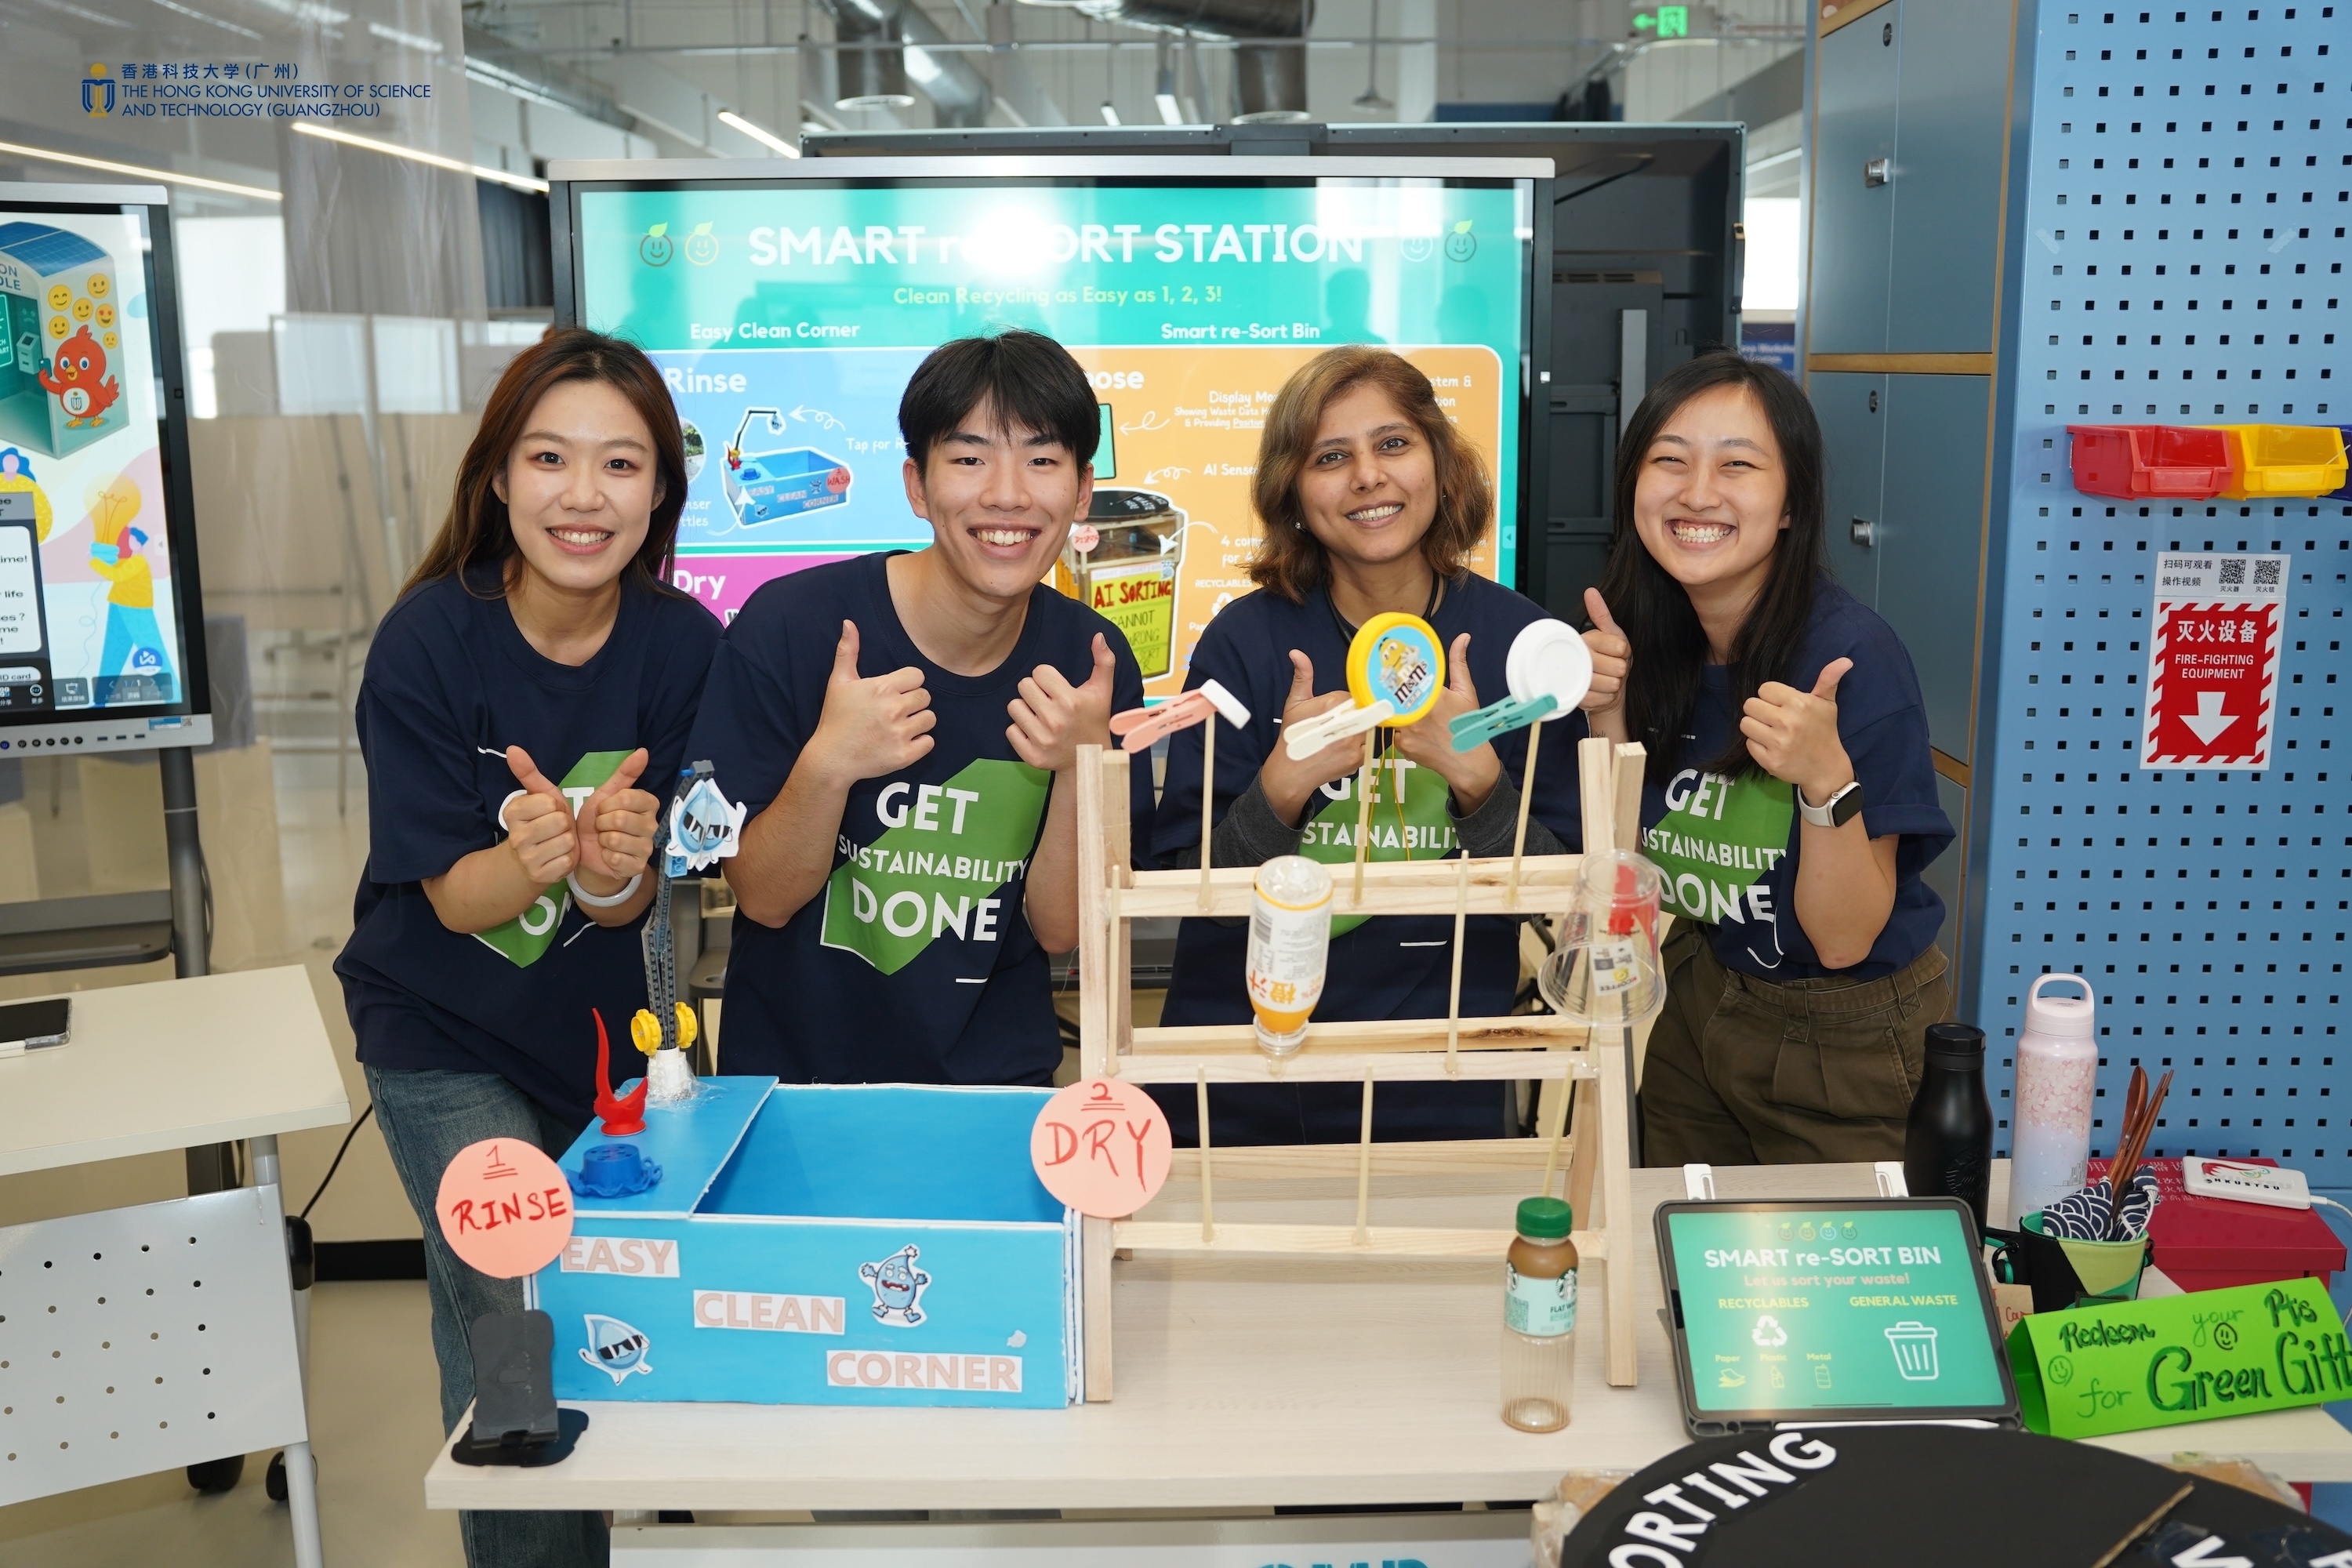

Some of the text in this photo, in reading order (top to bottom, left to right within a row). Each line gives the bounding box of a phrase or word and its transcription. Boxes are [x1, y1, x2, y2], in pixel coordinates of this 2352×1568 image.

[749, 225, 926, 266] SMART
[1154, 223, 1363, 263] STATION
[894, 285, 1222, 307] Clean Recycling as Easy as 1, 2, 3!
[691, 322, 860, 342] Easy Clean Corner
[1161, 323, 1320, 339] Smart re-Sort Bin
[665, 368, 747, 393] Rinse
[1209, 391, 1252, 407] Display
[1174, 407, 1207, 418] Showing
[1210, 407, 1236, 416] Waste
[1239, 407, 1259, 416] Data
[1193, 418, 1231, 430] Providing
[846, 437, 869, 455] Tap
[872, 440, 891, 454] for
[1203, 463, 1218, 476] AI
[827, 476, 851, 487] WASH
[804, 496, 838, 508] CORNER
[1221, 535, 1231, 547] 4
[1222, 554, 1240, 568] for
[2163, 559, 2213, 570] 扫码可观看
[673, 569, 727, 600] Dry
[1194, 579, 1253, 588] RECYCLABLES
[2161, 576, 2201, 586] 操作视频
[5, 590, 24, 599] life
[1094, 579, 1172, 609] AI SORTING
[2176, 619, 2258, 643] 灭火设备
[2175, 654, 2254, 666] FIRE-FIGHTING
[2181, 668, 2245, 679] EQUIPMENT
[1664, 768, 1735, 821] GET
[876, 781, 979, 835] GET
[838, 833, 1030, 883] SUSTAINABILITY
[852, 877, 1001, 942] DONE
[1090, 1082, 1113, 1102] 2
[485, 1144, 506, 1169] 1
[1044, 1118, 1152, 1192] DRY
[2214, 1178, 2281, 1191] HKUSTSU
[451, 1187, 568, 1236] RINSE
[561, 1238, 674, 1275] EASY
[1704, 1246, 1942, 1268] SMART re-SORT BIN
[1743, 1272, 1911, 1288] Let us sort your waste!
[1718, 1298, 1809, 1309] RECYCLABLES
[1849, 1294, 1958, 1308] GENERAL WASTE
[695, 1292, 844, 1334] CLEAN
[2059, 1319, 2156, 1353] Redeem
[2191, 1308, 2245, 1348] your
[1715, 1354, 1741, 1363] Paper
[1759, 1353, 1788, 1362] Plastic
[1806, 1352, 1832, 1361] Metal
[828, 1352, 1019, 1390] CORNER
[2076, 1377, 2132, 1418] for
[2146, 1345, 2273, 1411] Green
